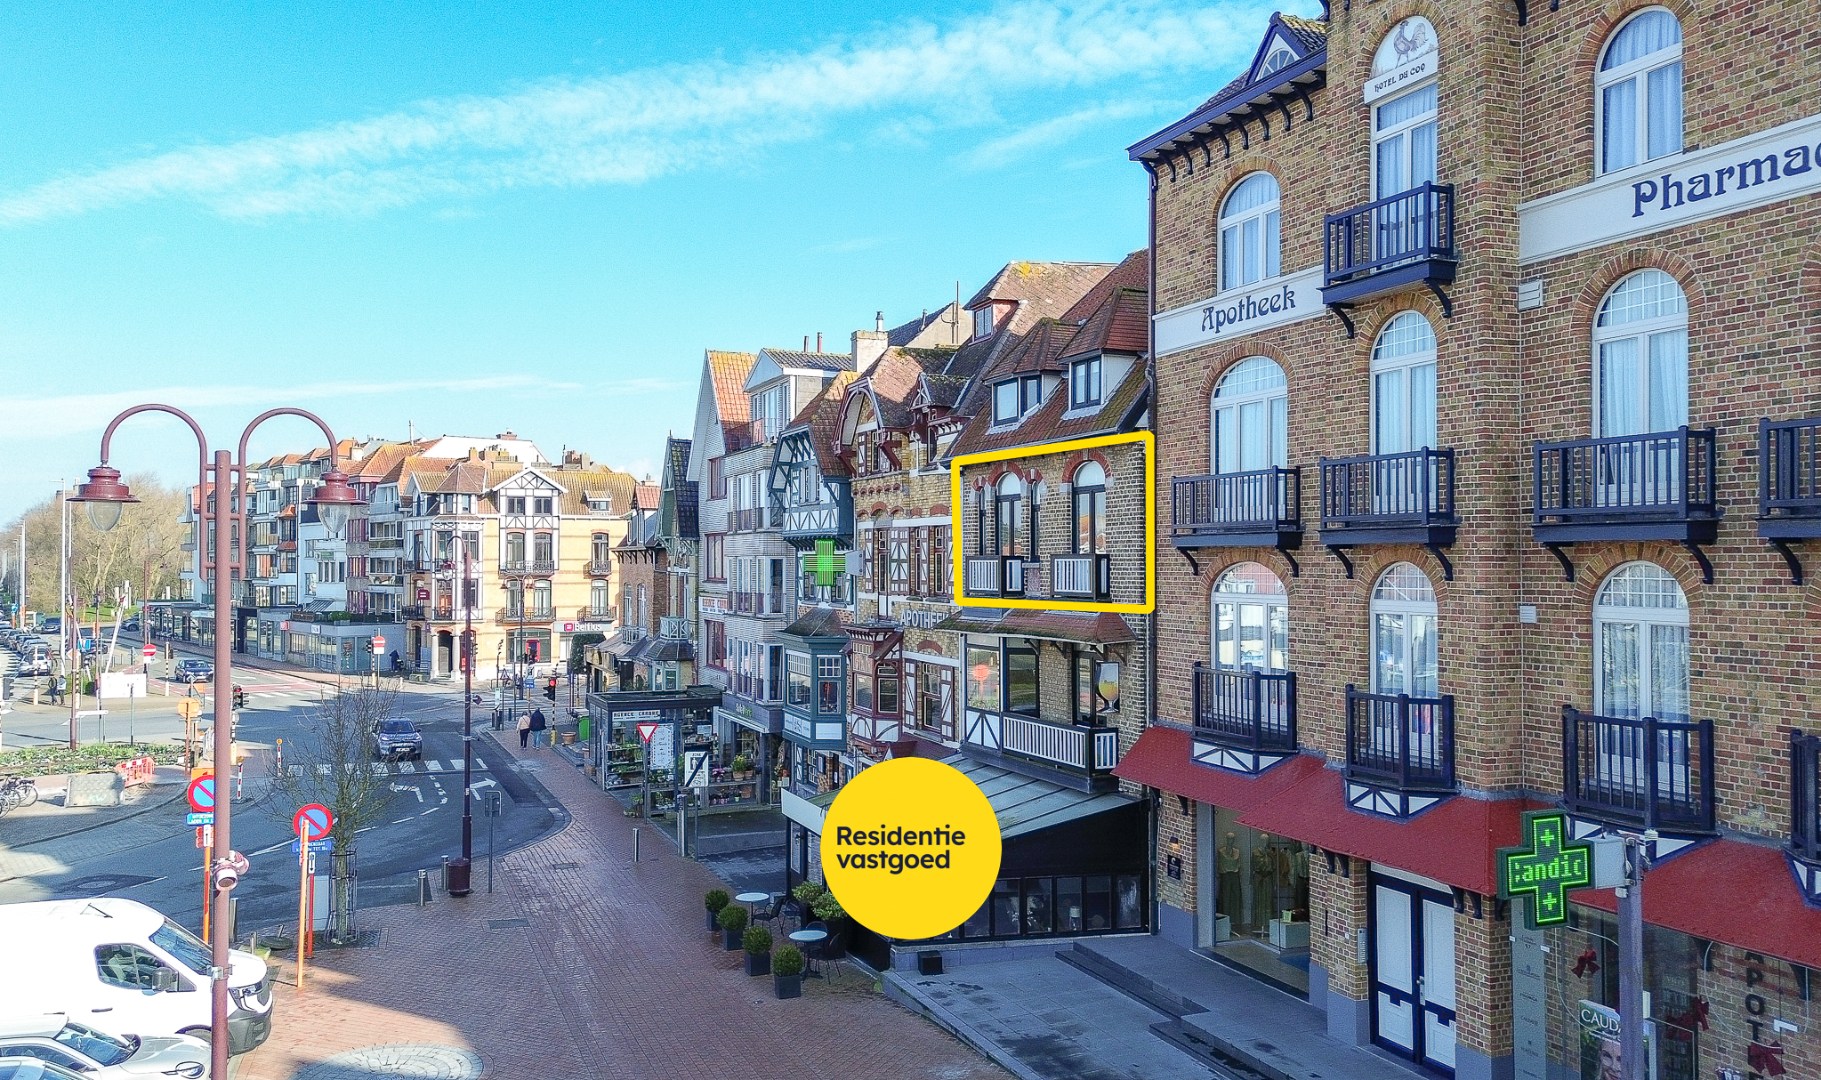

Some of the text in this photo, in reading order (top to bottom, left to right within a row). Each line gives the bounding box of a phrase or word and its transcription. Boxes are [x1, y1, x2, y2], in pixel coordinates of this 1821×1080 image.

[1374, 77, 1397, 93] HOTEL
[1410, 63, 1425, 76] COQ
[1632, 140, 1821, 218] Pharma
[1201, 284, 1296, 334] Apotheek
[575, 621, 601, 631] Belfius
[1581, 1009, 1621, 1034] CAUD
